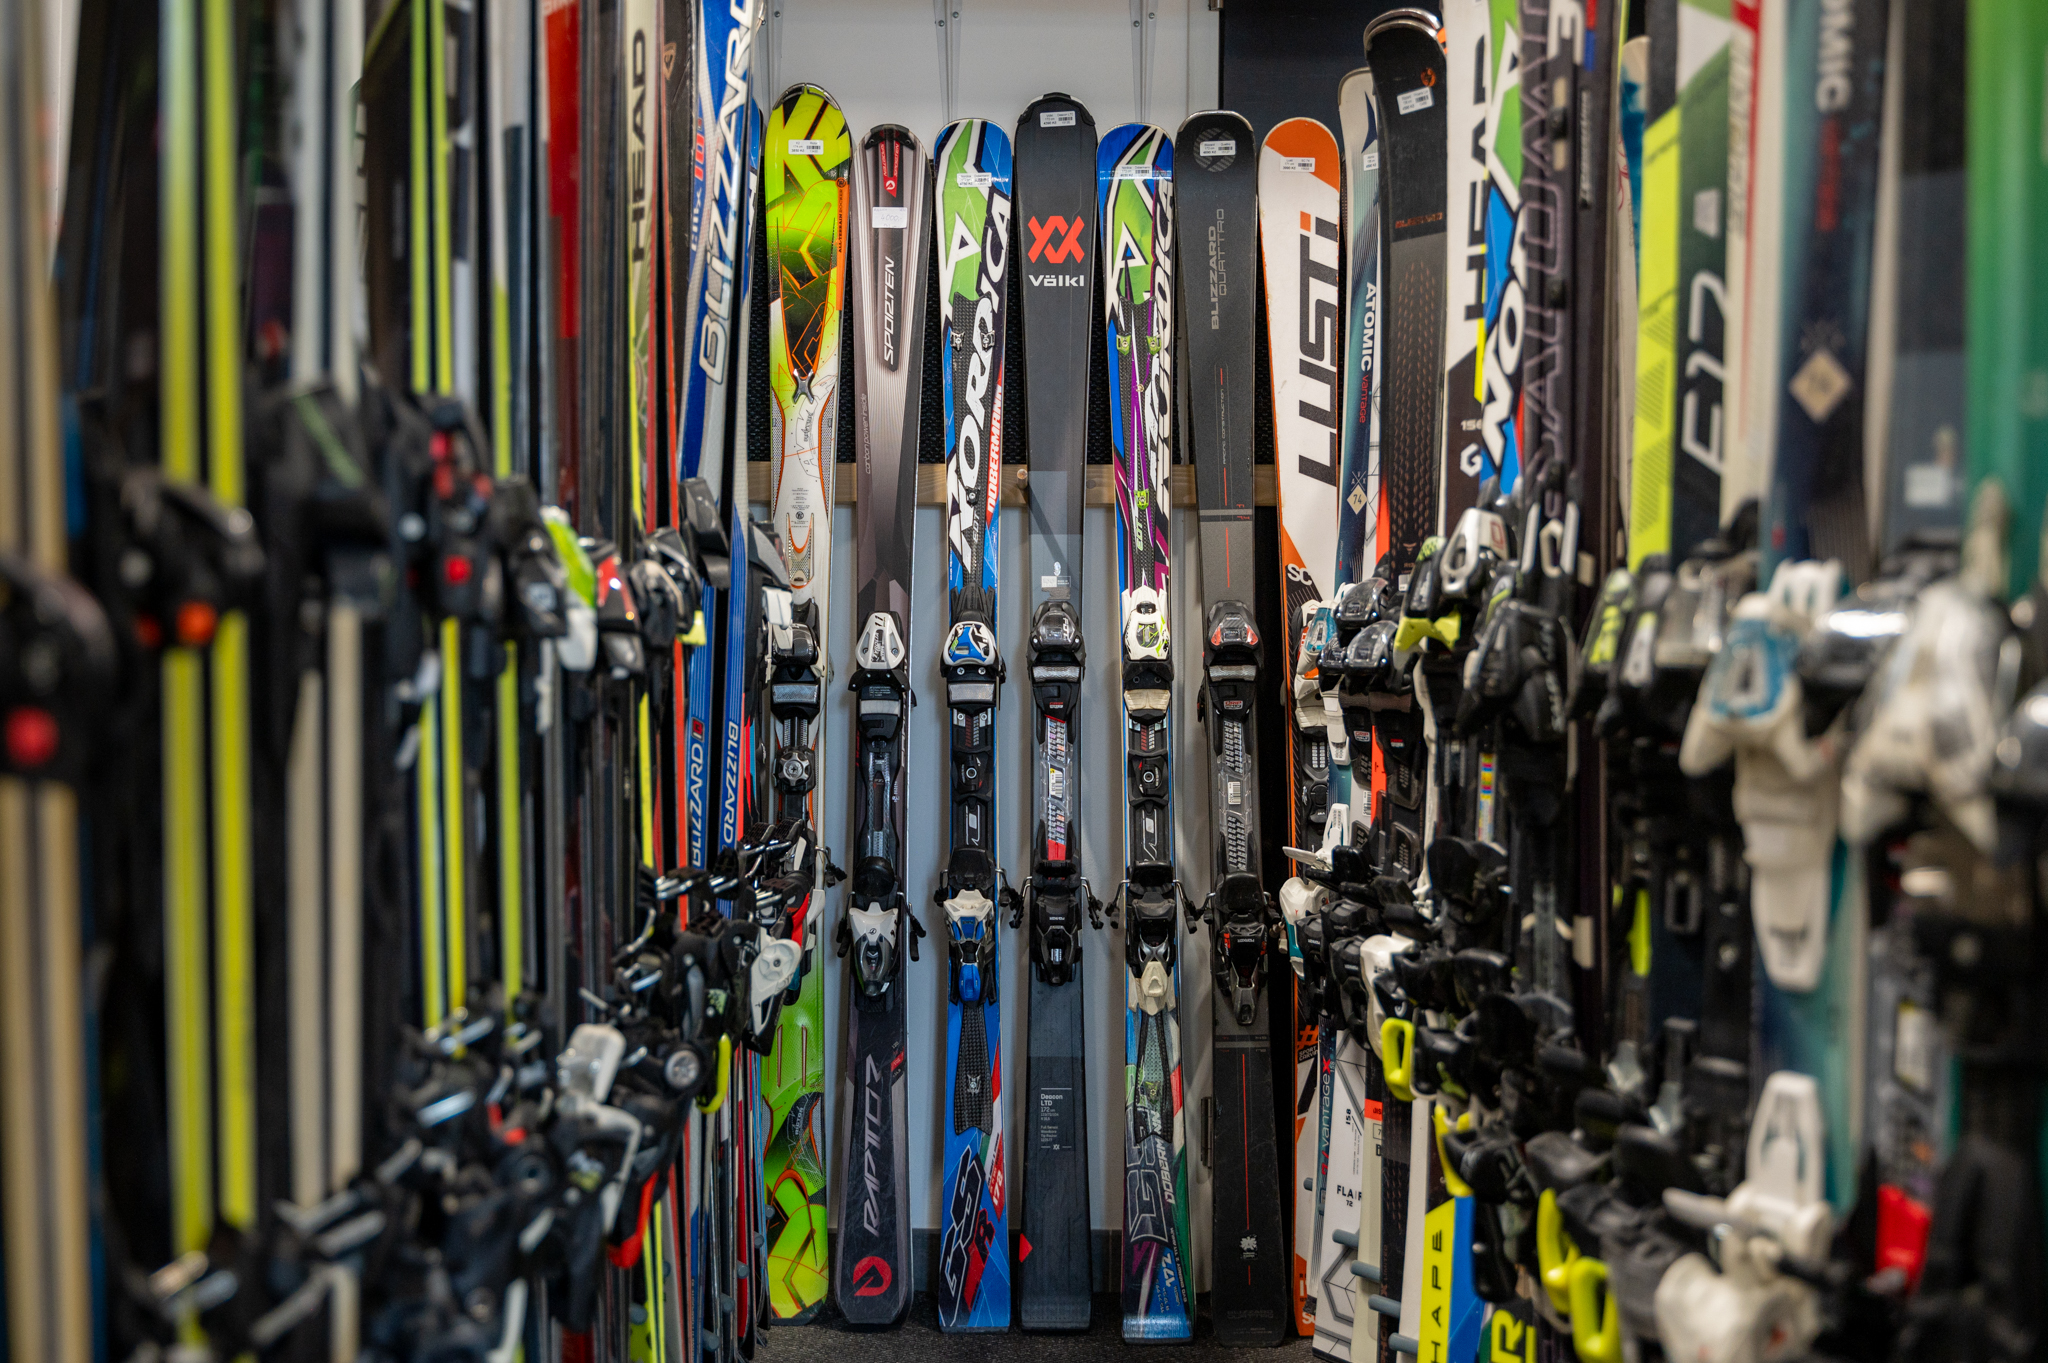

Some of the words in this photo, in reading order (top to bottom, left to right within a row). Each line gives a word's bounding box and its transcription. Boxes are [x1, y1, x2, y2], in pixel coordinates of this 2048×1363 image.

[632, 28, 647, 264] HEAD
[1028, 274, 1085, 287] Völkl
[1208, 226, 1220, 330] BLIZZARD
[1216, 208, 1227, 297] QUATTRO
[884, 256, 896, 365] SPORTEN
[1360, 281, 1377, 372] ATOMIC
[946, 192, 1012, 574] NORDICA
[1358, 374, 1370, 424] vantage
[862, 417, 871, 445] power
[1353, 494, 1362, 505] 74
[1286, 563, 1313, 586] SC
[863, 1053, 882, 1237] RAPTOR
[992, 1169, 1004, 1207] 178
[1161, 1252, 1176, 1288] 172
